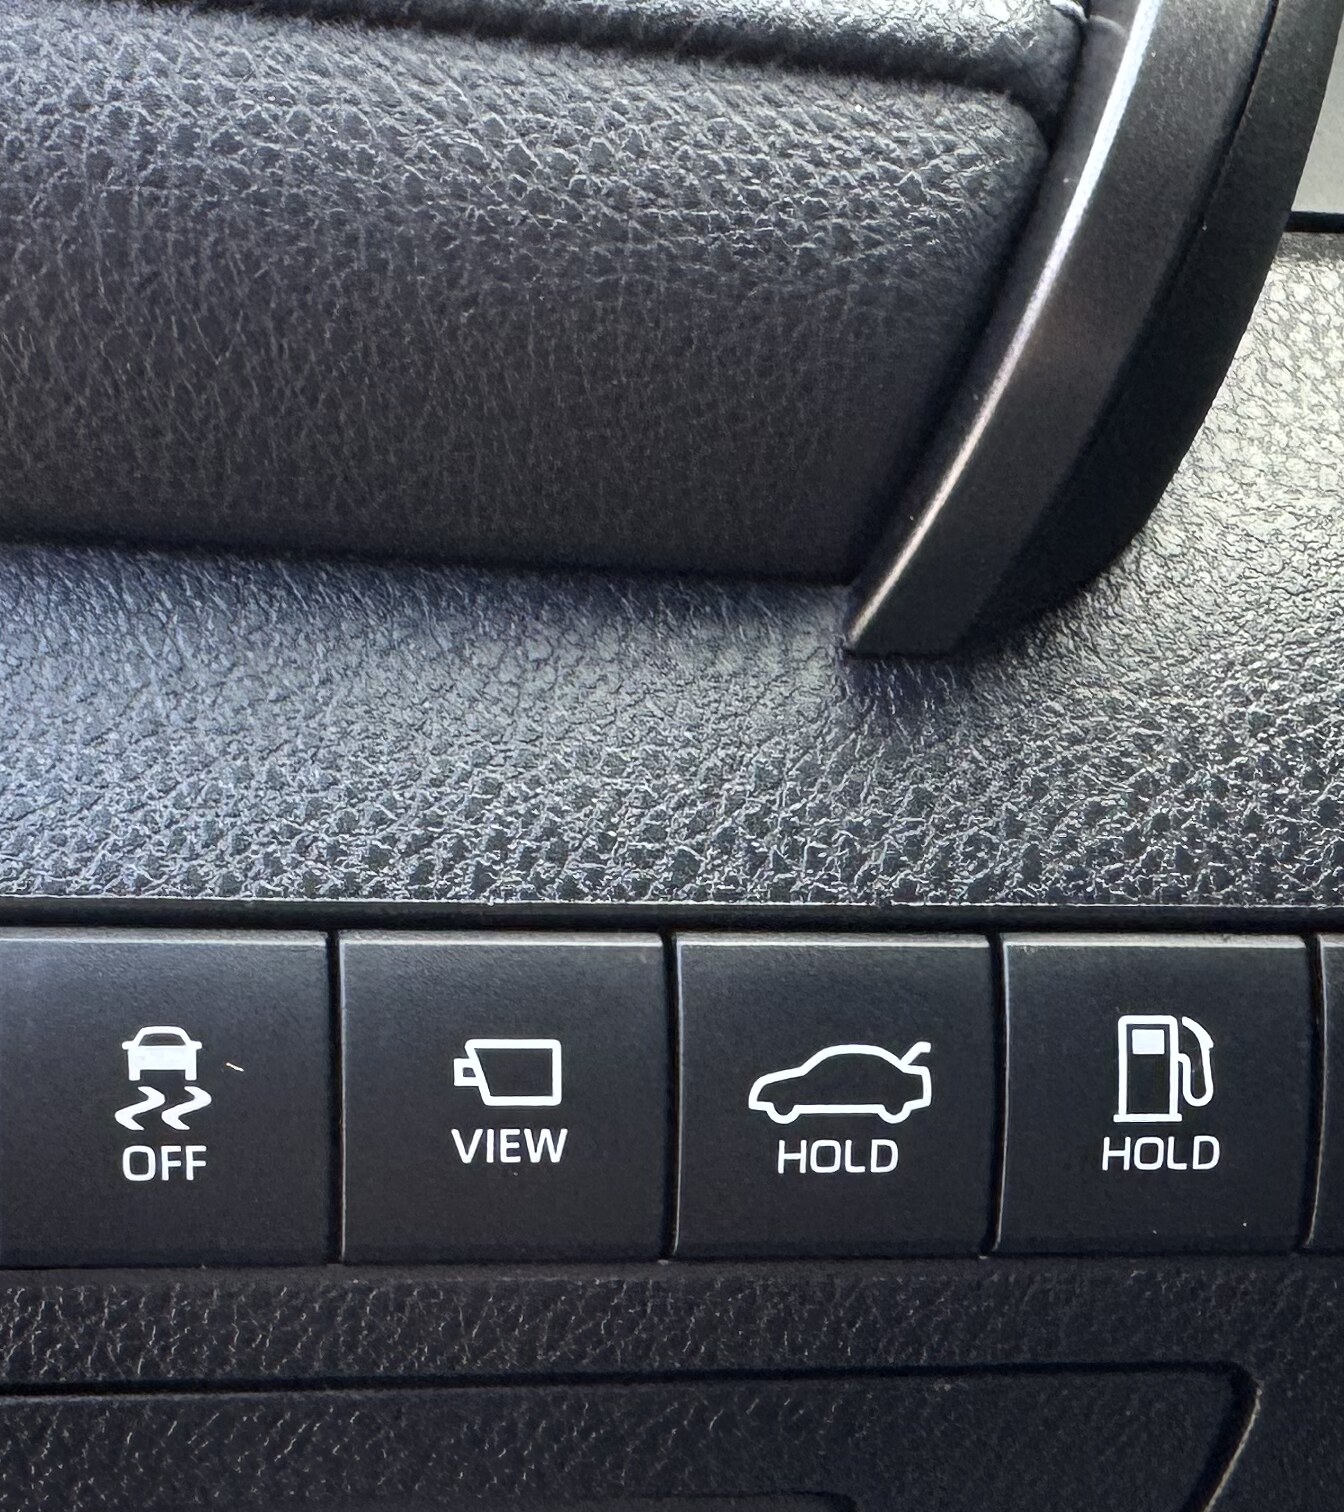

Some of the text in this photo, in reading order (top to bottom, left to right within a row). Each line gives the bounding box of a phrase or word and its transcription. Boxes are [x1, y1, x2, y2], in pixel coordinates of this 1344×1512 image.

[123, 1145, 206, 1181] OFF
[451, 1129, 568, 1163] VIEW
[778, 1139, 898, 1174] HOLD
[1102, 1136, 1220, 1170] HOLD
